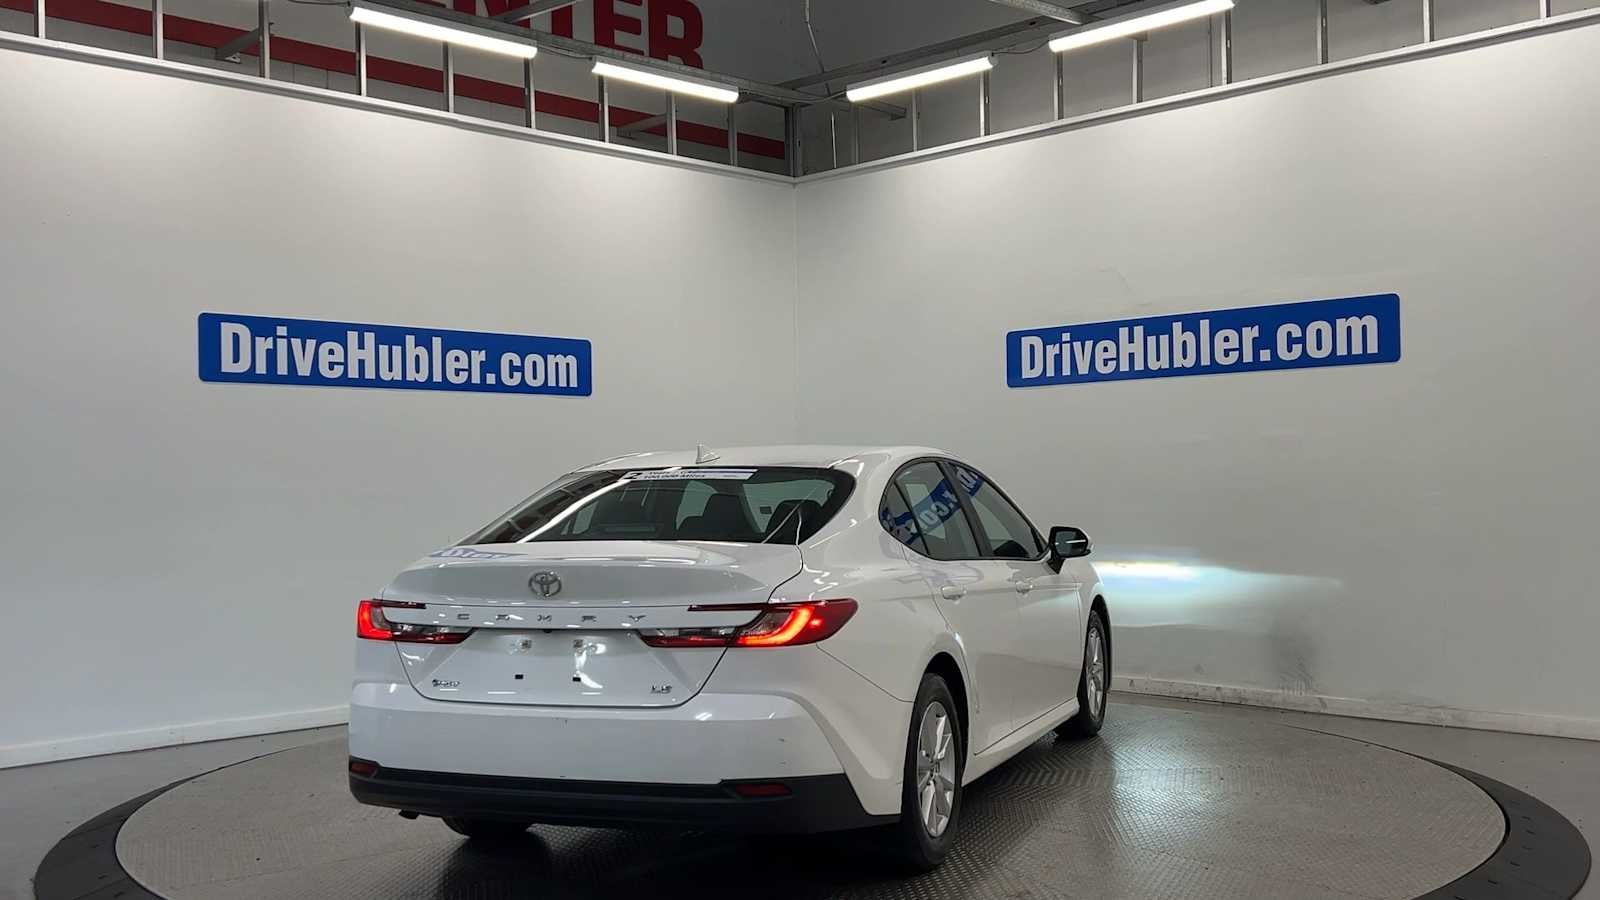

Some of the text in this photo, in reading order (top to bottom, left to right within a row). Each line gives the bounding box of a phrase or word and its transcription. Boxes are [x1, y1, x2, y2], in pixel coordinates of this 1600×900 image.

[220, 322, 578, 388] DriveHubler.com
[1020, 313, 1379, 379] DriveHubler.com
[456, 612, 647, 624] CAMRY
